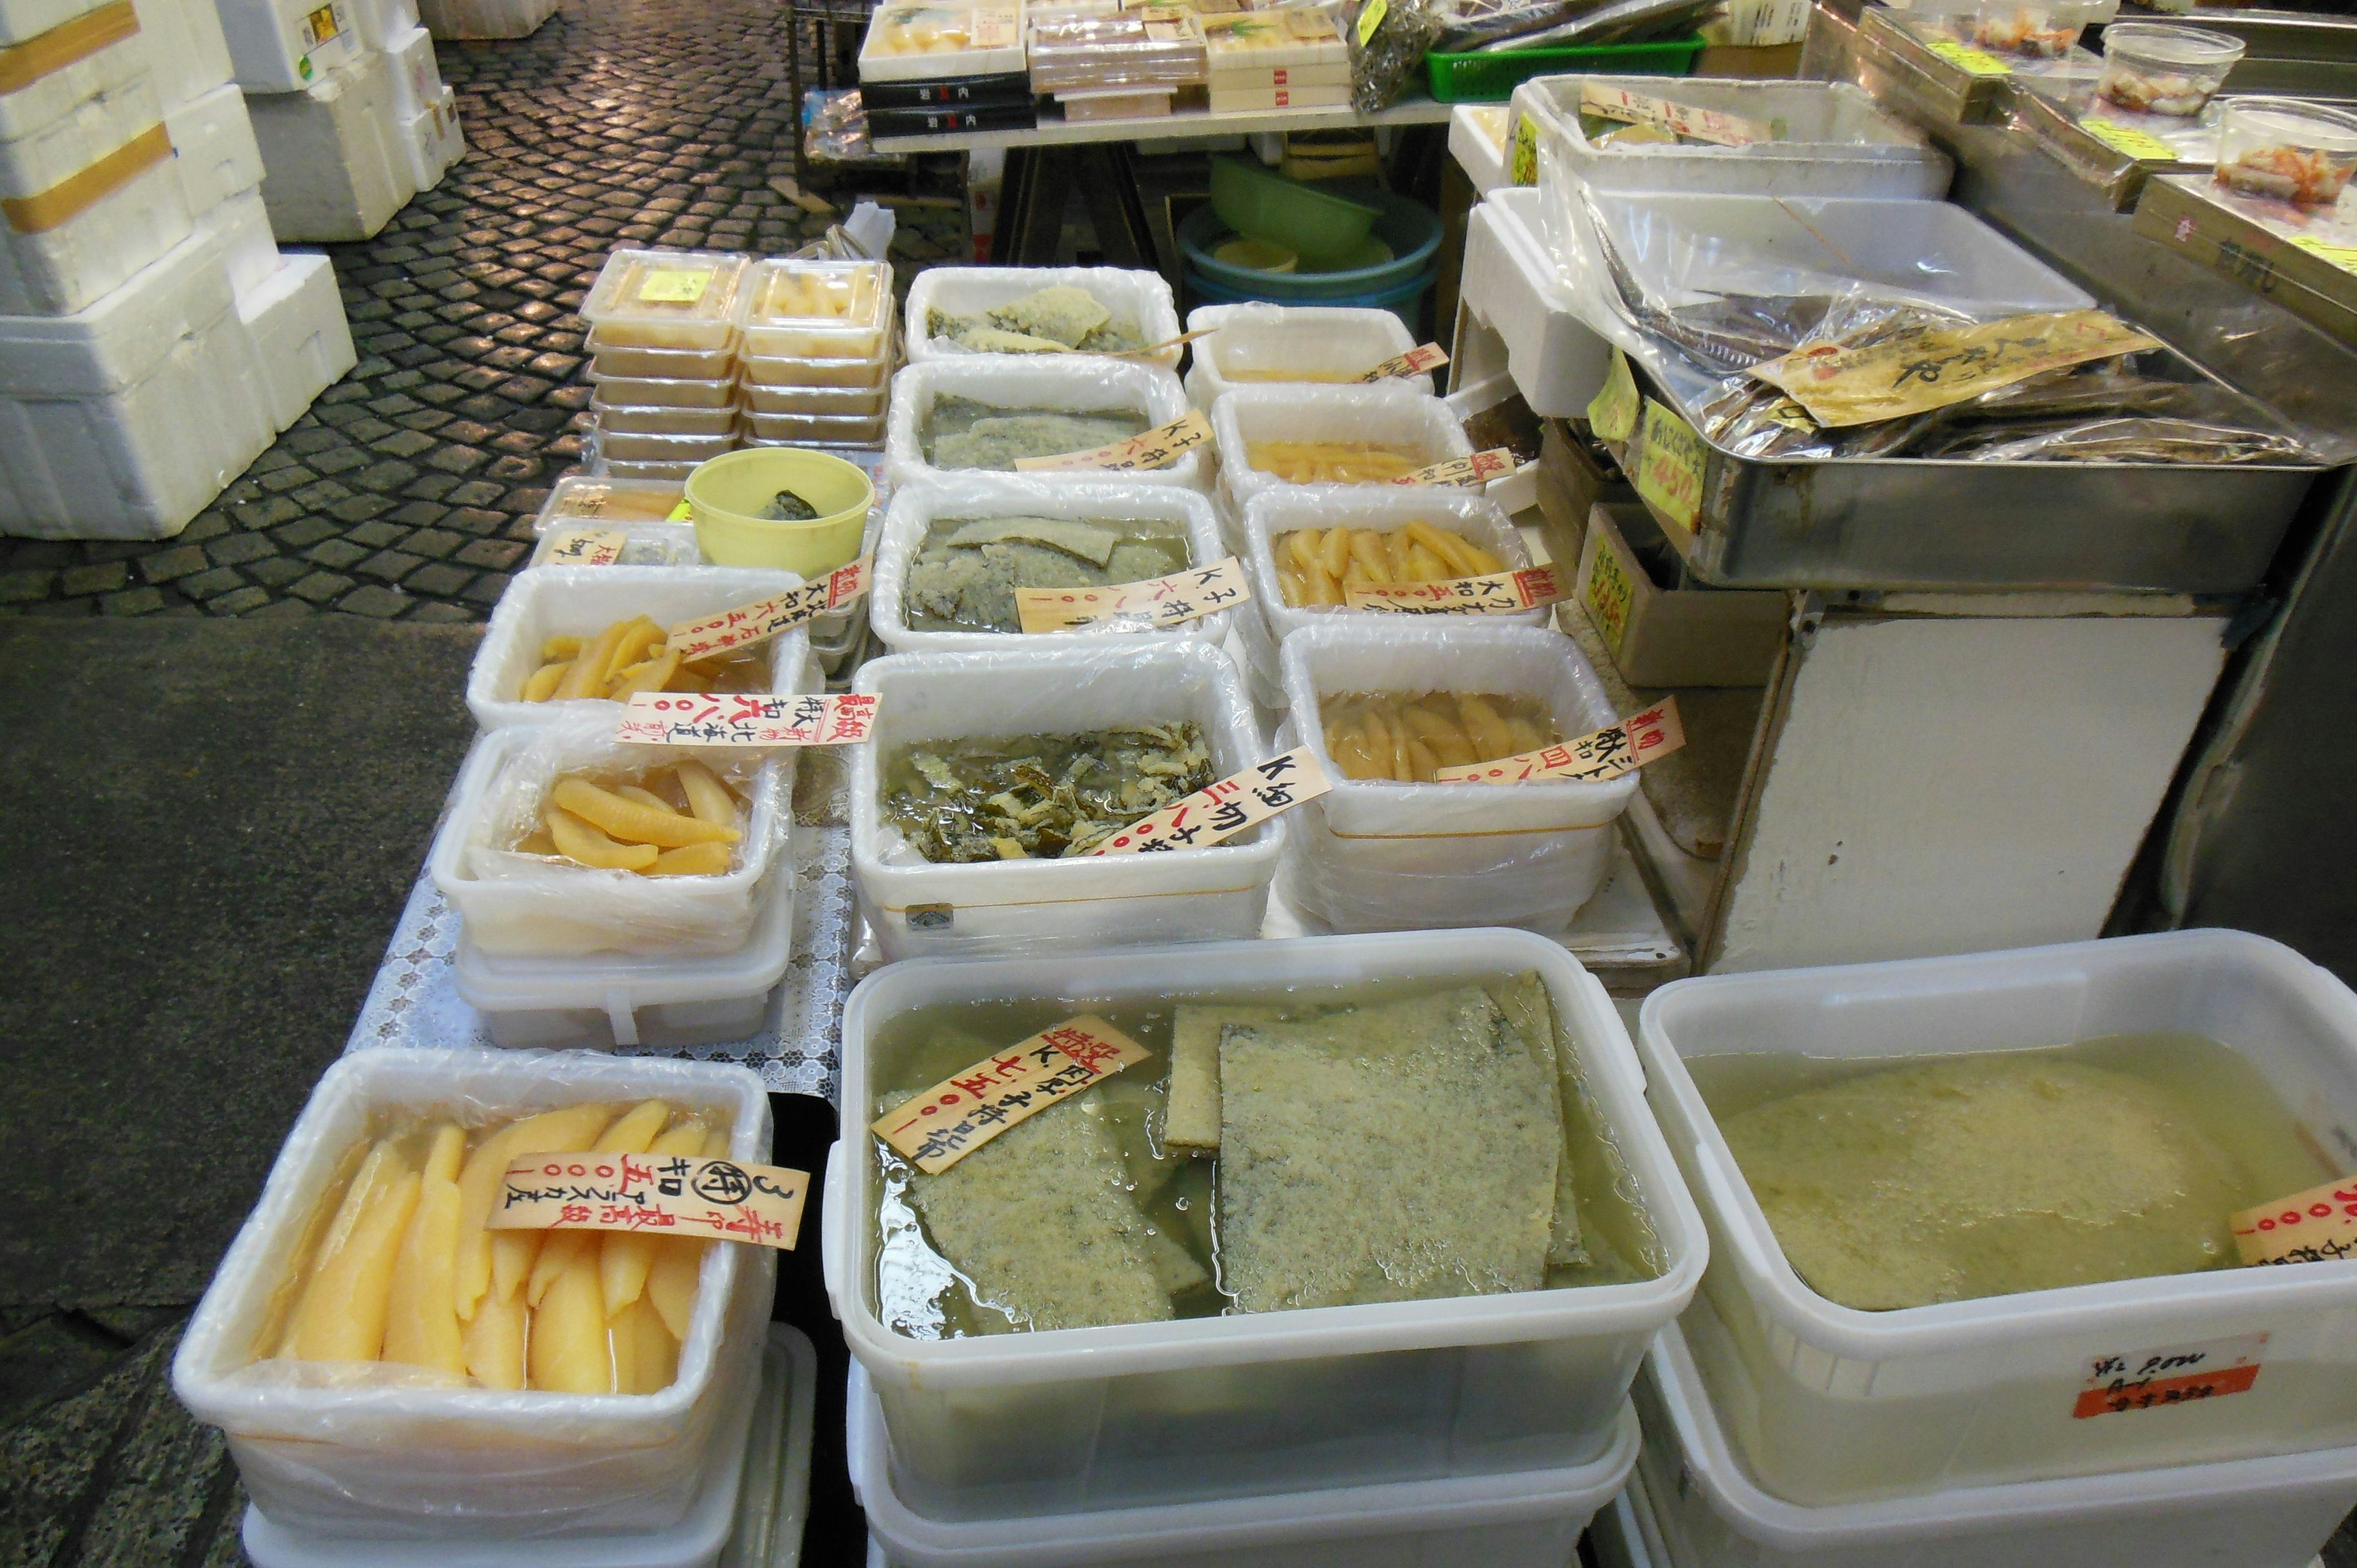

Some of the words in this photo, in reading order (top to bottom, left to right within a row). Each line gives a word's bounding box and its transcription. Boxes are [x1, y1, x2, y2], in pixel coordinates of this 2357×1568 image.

[830, 694, 874, 740] 最高級
[665, 720, 757, 743] 北海道
[504, 1182, 646, 1210] アラスカ産
